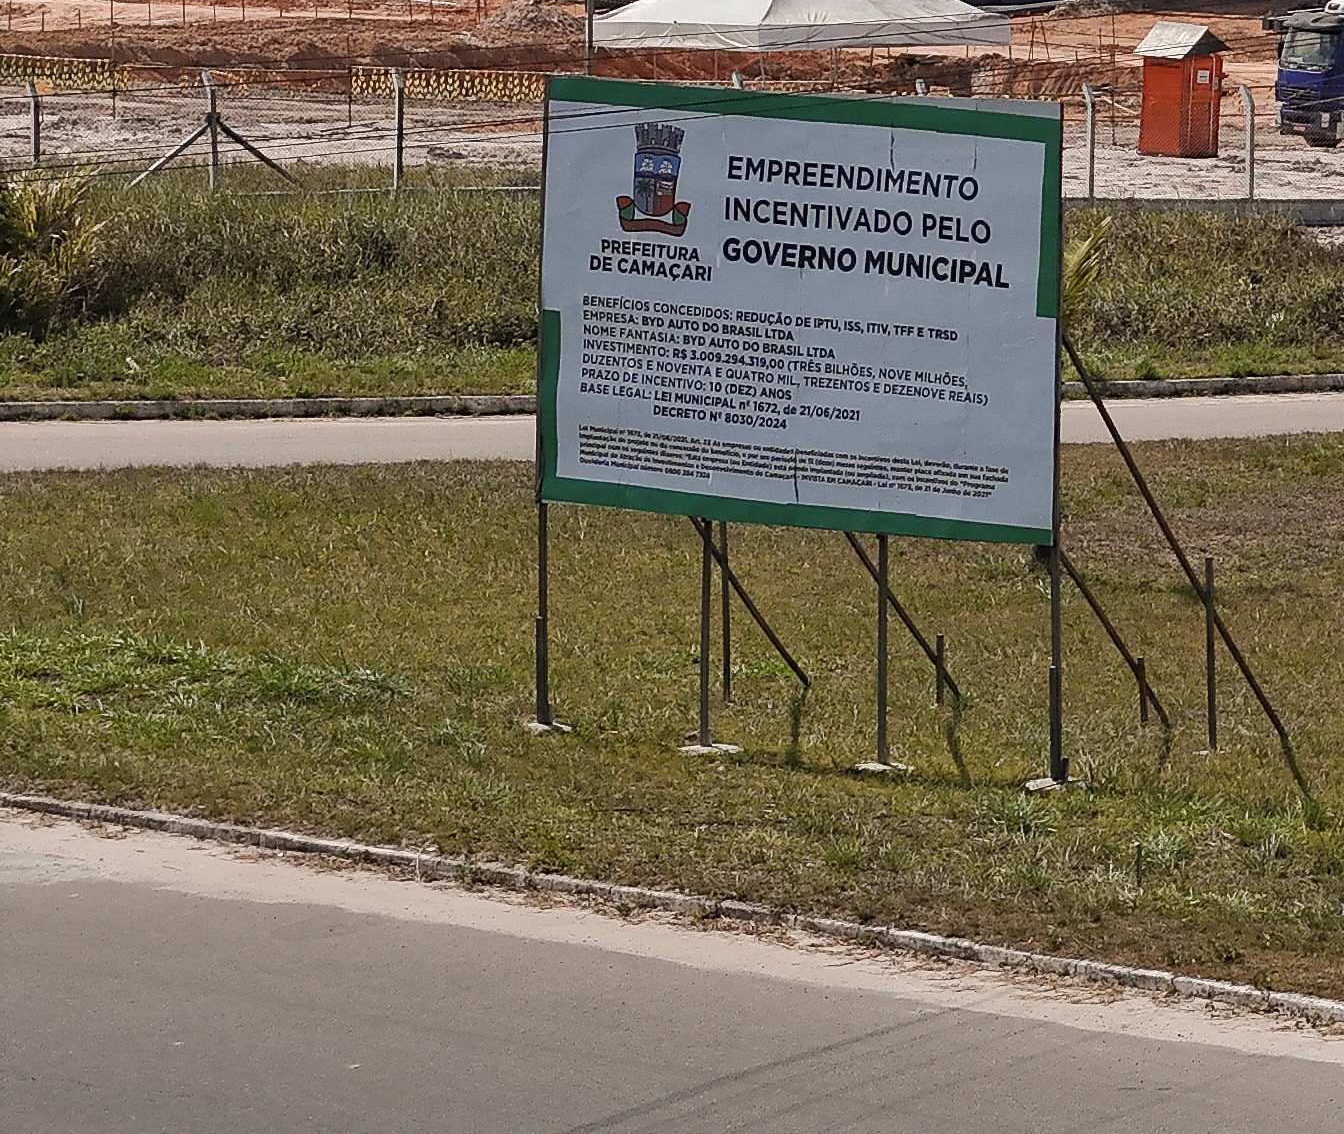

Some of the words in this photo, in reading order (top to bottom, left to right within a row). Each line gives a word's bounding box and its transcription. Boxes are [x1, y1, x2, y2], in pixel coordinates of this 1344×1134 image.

[728, 156, 978, 201] EMPREENDIMENTO
[725, 196, 912, 236] INCENTIVADO
[922, 214, 990, 244] PELO
[589, 255, 612, 272] DE
[617, 258, 711, 284] CAMAÇARI
[601, 239, 699, 261] PREFEITURA
[723, 237, 856, 273] GOVERNO
[864, 250, 1008, 288] MUNICIPAL
[583, 293, 649, 311] BENEFÍCIOS
[653, 302, 732, 320] CONCEDIDOS:
[736, 308, 792, 327] REDUÇÃO
[795, 316, 811, 327] DE
[813, 317, 841, 331] IPTU,
[844, 320, 863, 333] ISS,
[866, 322, 890, 336] ITIV,
[893, 324, 914, 336] TFF
[917, 326, 924, 337] E
[928, 328, 957, 341] TRSD
[583, 309, 638, 325] EMPRESA:
[641, 315, 664, 327] BYD
[668, 318, 699, 331] AUTO
[702, 322, 719, 333] DO
[722, 324, 762, 338] BRASIL
[765, 328, 793, 341] LTDA
[583, 324, 616, 337] NOME
[619, 327, 679, 344] FANTASIA:
[683, 334, 705, 346] BYD
[709, 337, 739, 350] AUTO
[742, 340, 759, 352] DO
[762, 342, 803, 356] BRASIL
[806, 346, 835, 359] LTDA
[582, 353, 643, 368] DUZENTOS
[646, 359, 653, 370] E
[656, 361, 711, 376] NOVENTA
[715, 367, 722, 377] E
[726, 368, 774, 383] QUATRO
[777, 374, 800, 387] MIL,
[804, 375, 869, 392] TREZENTOS
[873, 382, 880, 393] E
[883, 383, 945, 399] DEZENOVE
[949, 390, 988, 404] REAIS)
[583, 338, 670, 356] INVESTIMENTO:
[672, 348, 687, 359] R$
[690, 350, 784, 369] 3.009.294.319,00
[787, 357, 821, 373] (TRÊS
[824, 360, 875, 378] BILHÕES,
[878, 367, 911, 380] NOVE
[914, 369, 968, 388] MILHÕES,
[580, 382, 609, 394] BASE
[612, 385, 651, 399] LEGAL:
[654, 390, 672, 402] LEI
[674, 392, 736, 408] MUNICIPAL
[753, 401, 780, 415] 1672,
[783, 405, 796, 415] de
[799, 404, 859, 421] 21/06/2021
[581, 367, 619, 381] PRAZO
[622, 371, 638, 383] DE
[641, 374, 706, 391] INCENTIVO:
[709, 381, 722, 392] 10
[725, 383, 756, 397] (DEZ)
[760, 387, 791, 400] ANOS
[653, 405, 706, 420] DECRETO
[724, 413, 786, 429] 8030/2024
